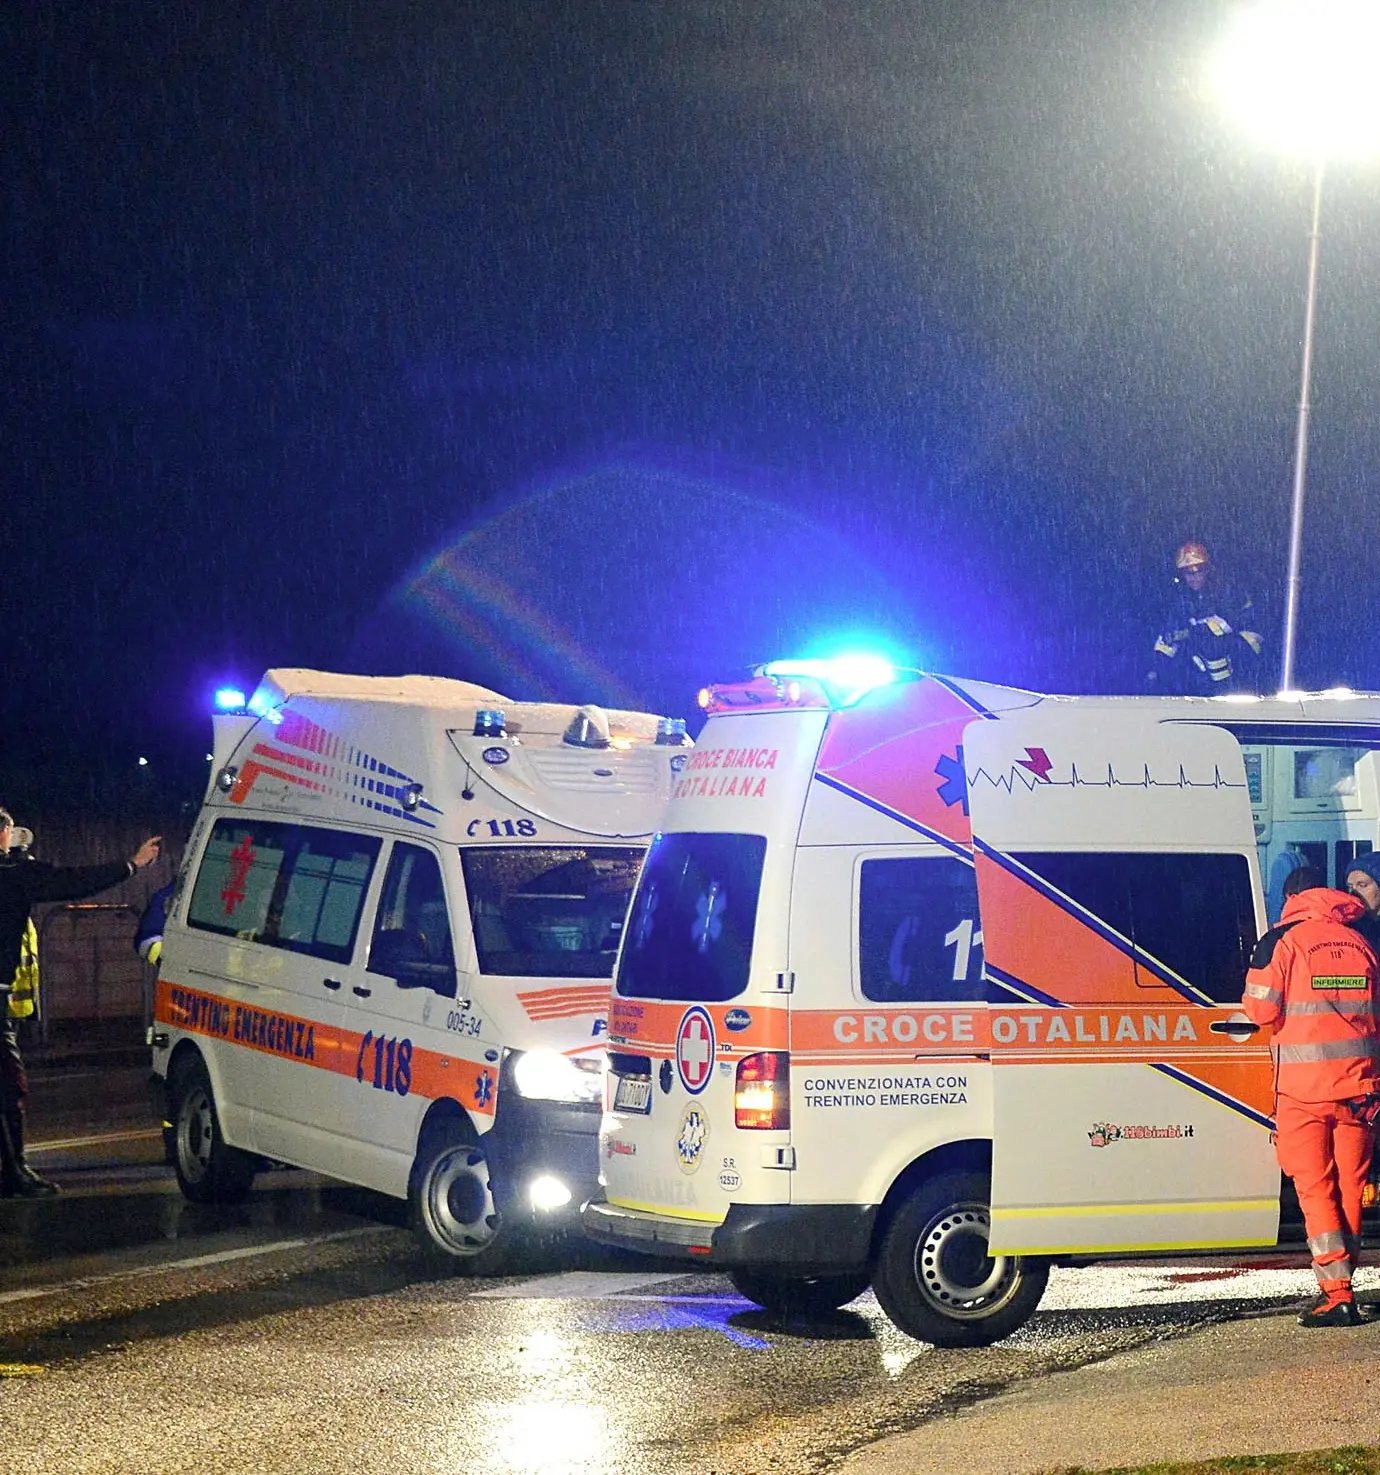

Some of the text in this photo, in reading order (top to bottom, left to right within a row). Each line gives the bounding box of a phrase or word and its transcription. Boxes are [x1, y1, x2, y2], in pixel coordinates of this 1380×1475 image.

[685, 747, 779, 771] CROCE BIANCA
[673, 775, 768, 799] ROTALIANA
[486, 818, 538, 838] 118
[1313, 978, 1365, 987] INFERMIERE
[170, 988, 316, 1061] TRENTINO EMERGENZA
[446, 1010, 482, 1038] 005-34
[832, 1014, 974, 1044] CROCE
[992, 1014, 1198, 1043] OTALIANA
[372, 1033, 413, 1097] 118
[804, 1076, 967, 1092] CONVENZIONATA CON
[804, 1092, 968, 1107] TRENTINO EMERGENZA
[722, 1157, 737, 1169] S.R.
[719, 1174, 740, 1186] 12537
